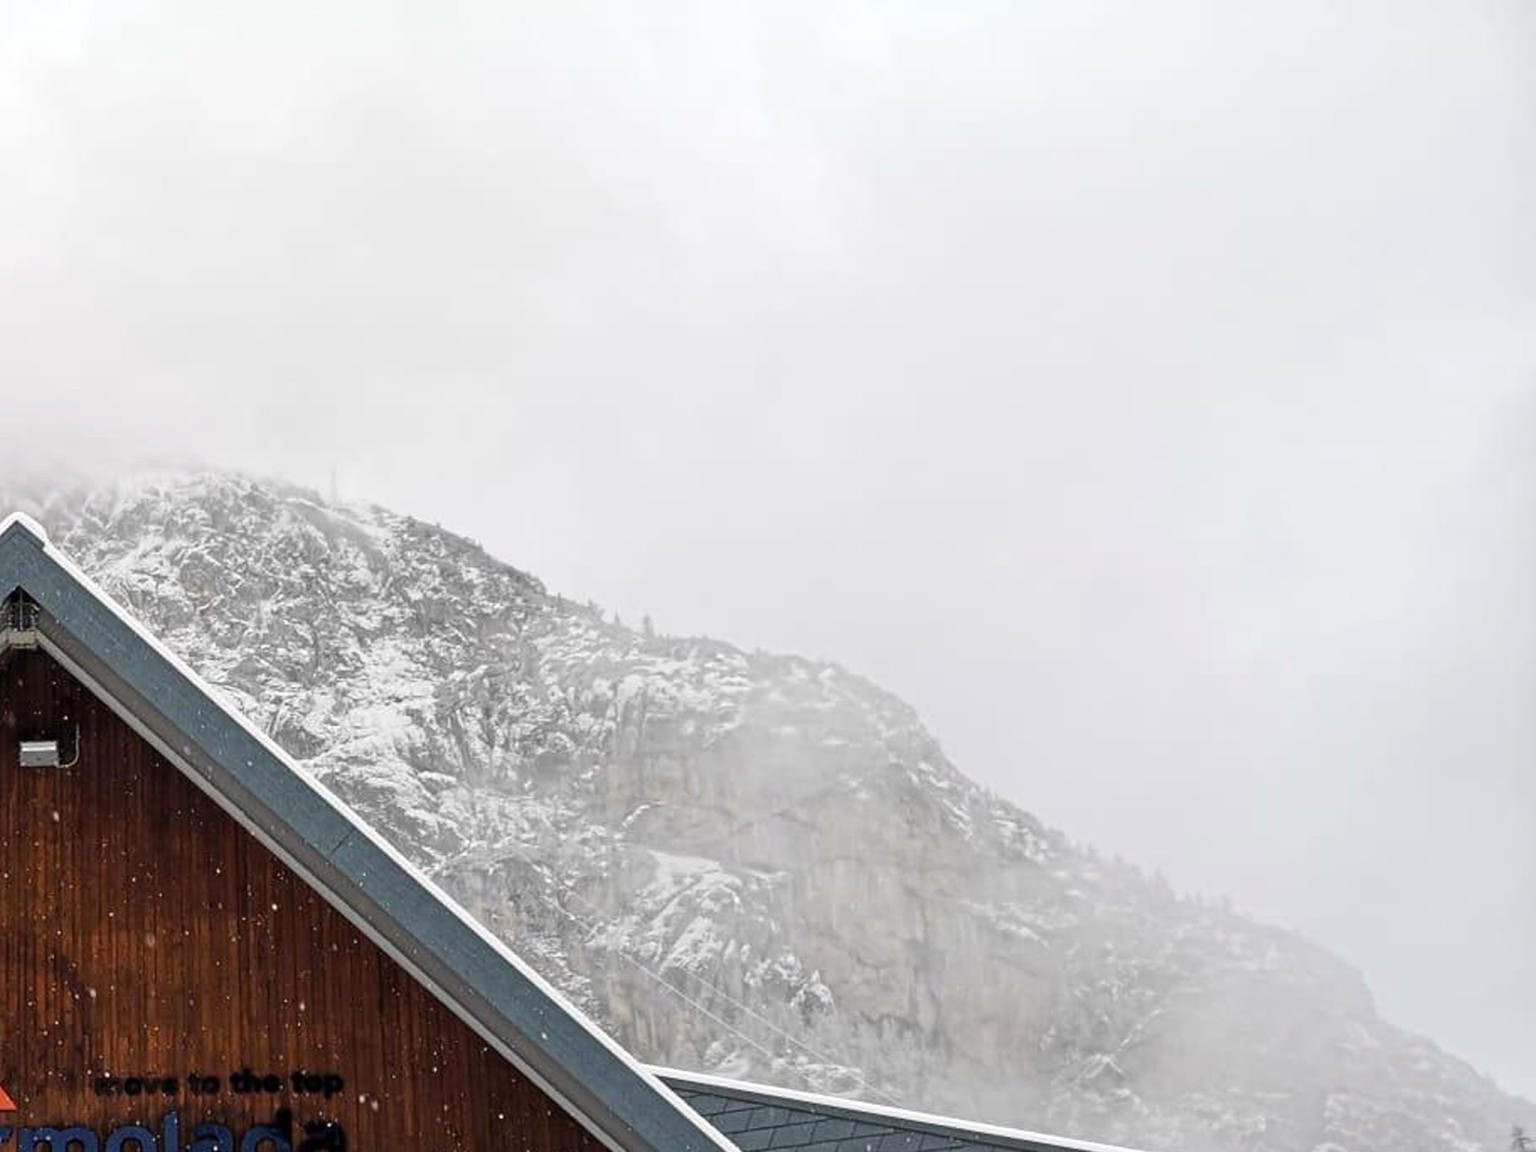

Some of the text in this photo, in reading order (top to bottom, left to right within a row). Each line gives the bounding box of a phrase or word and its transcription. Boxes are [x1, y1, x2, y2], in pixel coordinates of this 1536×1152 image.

[94, 1068, 344, 1099] move to the top
